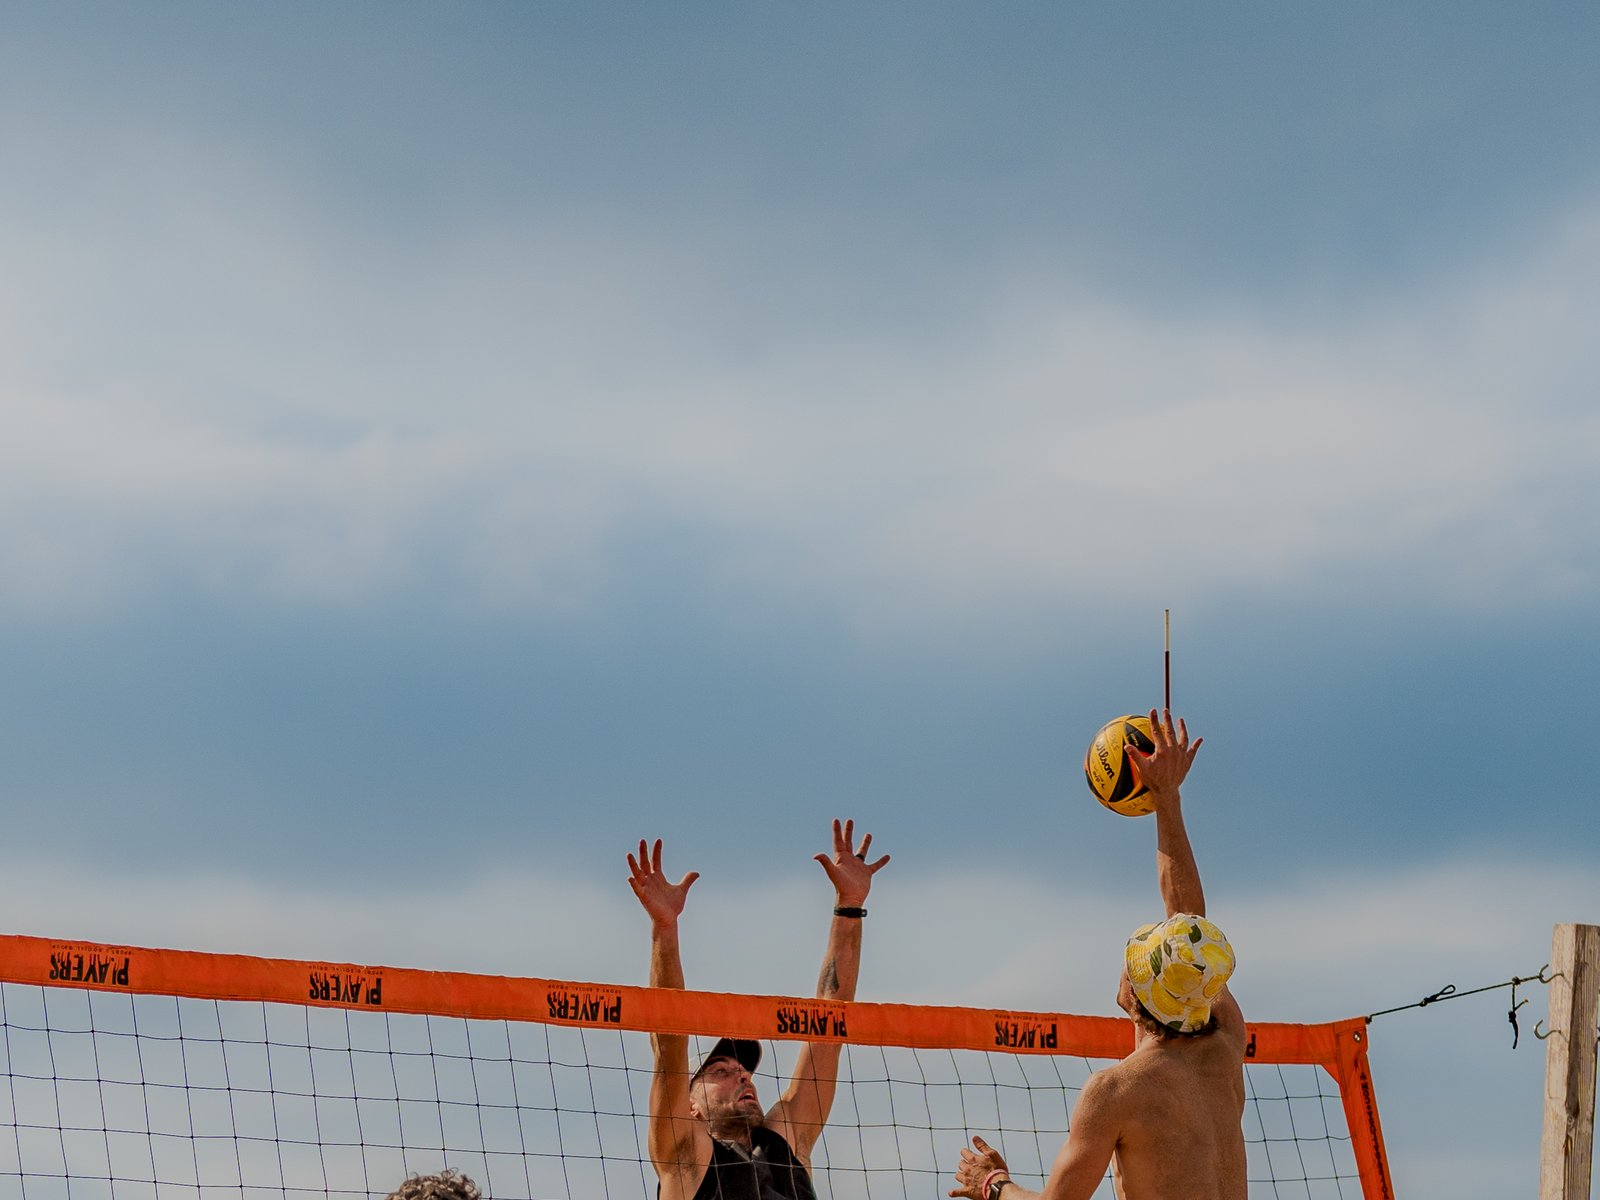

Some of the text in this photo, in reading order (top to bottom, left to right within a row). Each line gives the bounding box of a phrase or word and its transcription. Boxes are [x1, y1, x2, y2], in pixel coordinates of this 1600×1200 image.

[49, 952, 130, 985] PLAYERS
[309, 972, 382, 1005] PLAYERS
[547, 991, 622, 1023] PLAYERS
[777, 1008, 848, 1037] PLAYERS
[994, 1021, 1057, 1048] PLAYERS
